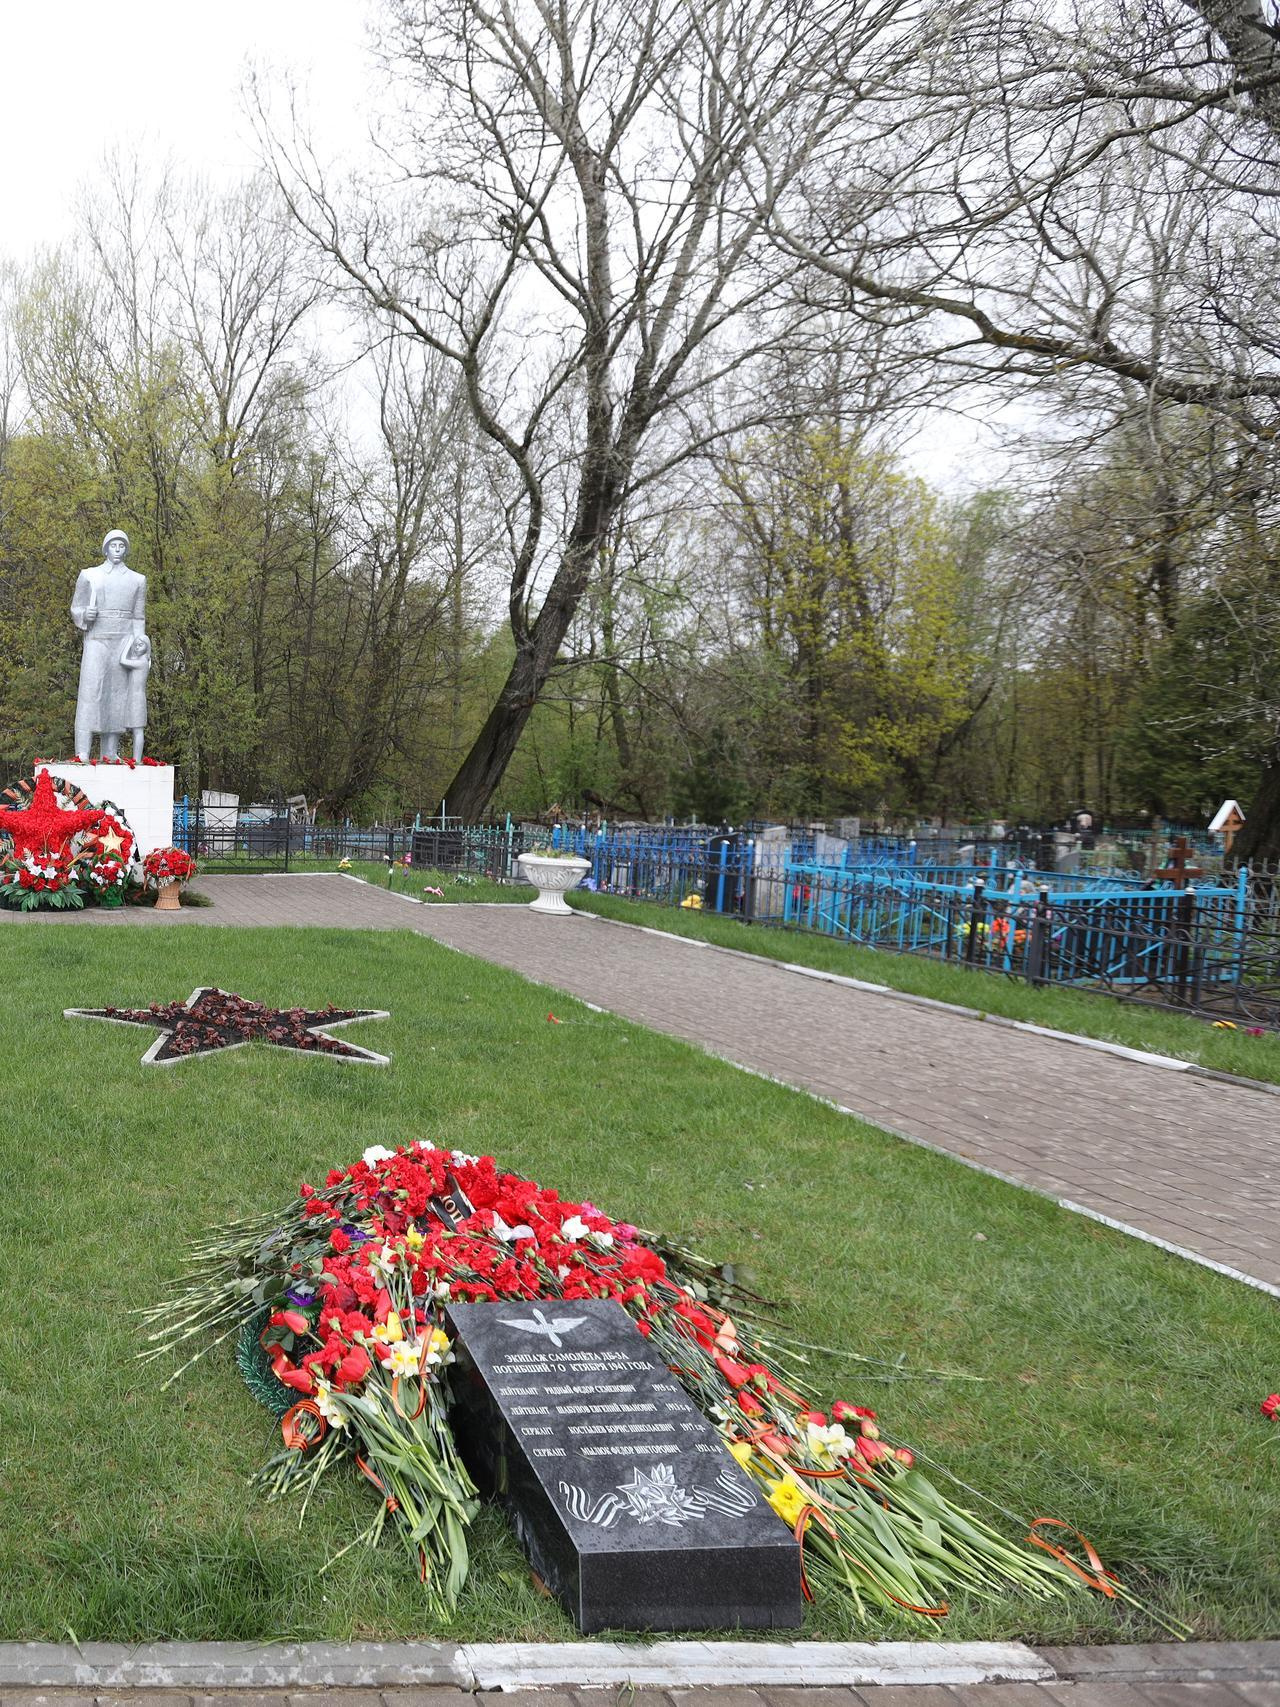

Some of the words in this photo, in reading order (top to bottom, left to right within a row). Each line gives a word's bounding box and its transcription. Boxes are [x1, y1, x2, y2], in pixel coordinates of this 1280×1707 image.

[504, 1353, 549, 1363] ЭКИПАЖ
[549, 1351, 602, 1362] САМОЛЁТА
[602, 1352, 629, 1362] ДБ-3А
[492, 1363, 552, 1374] ПОГИБШИЙ
[608, 1362, 629, 1371] 1941
[627, 1361, 655, 1371] ГОДА
[499, 1386, 539, 1396] ЛЕЙТЕНАНТ
[510, 1405, 550, 1415] ЛЕЙТЕНАНТ
[589, 1403, 621, 1413] ЕВГЕНИЙ
[619, 1403, 658, 1412] ИВАНОВИЧ
[520, 1426, 554, 1436] СЕРЖАНТ
[568, 1425, 608, 1435] КОСТЫЛЕВ
[605, 1424, 631, 1434] БОРИС
[629, 1423, 676, 1432] НИКОЛАЕВИЧ
[532, 1447, 567, 1457] СЕРЖАНТ
[610, 1445, 635, 1456] ФЕДОР
[633, 1444, 682, 1455] ВИКТОРОВИЧ
